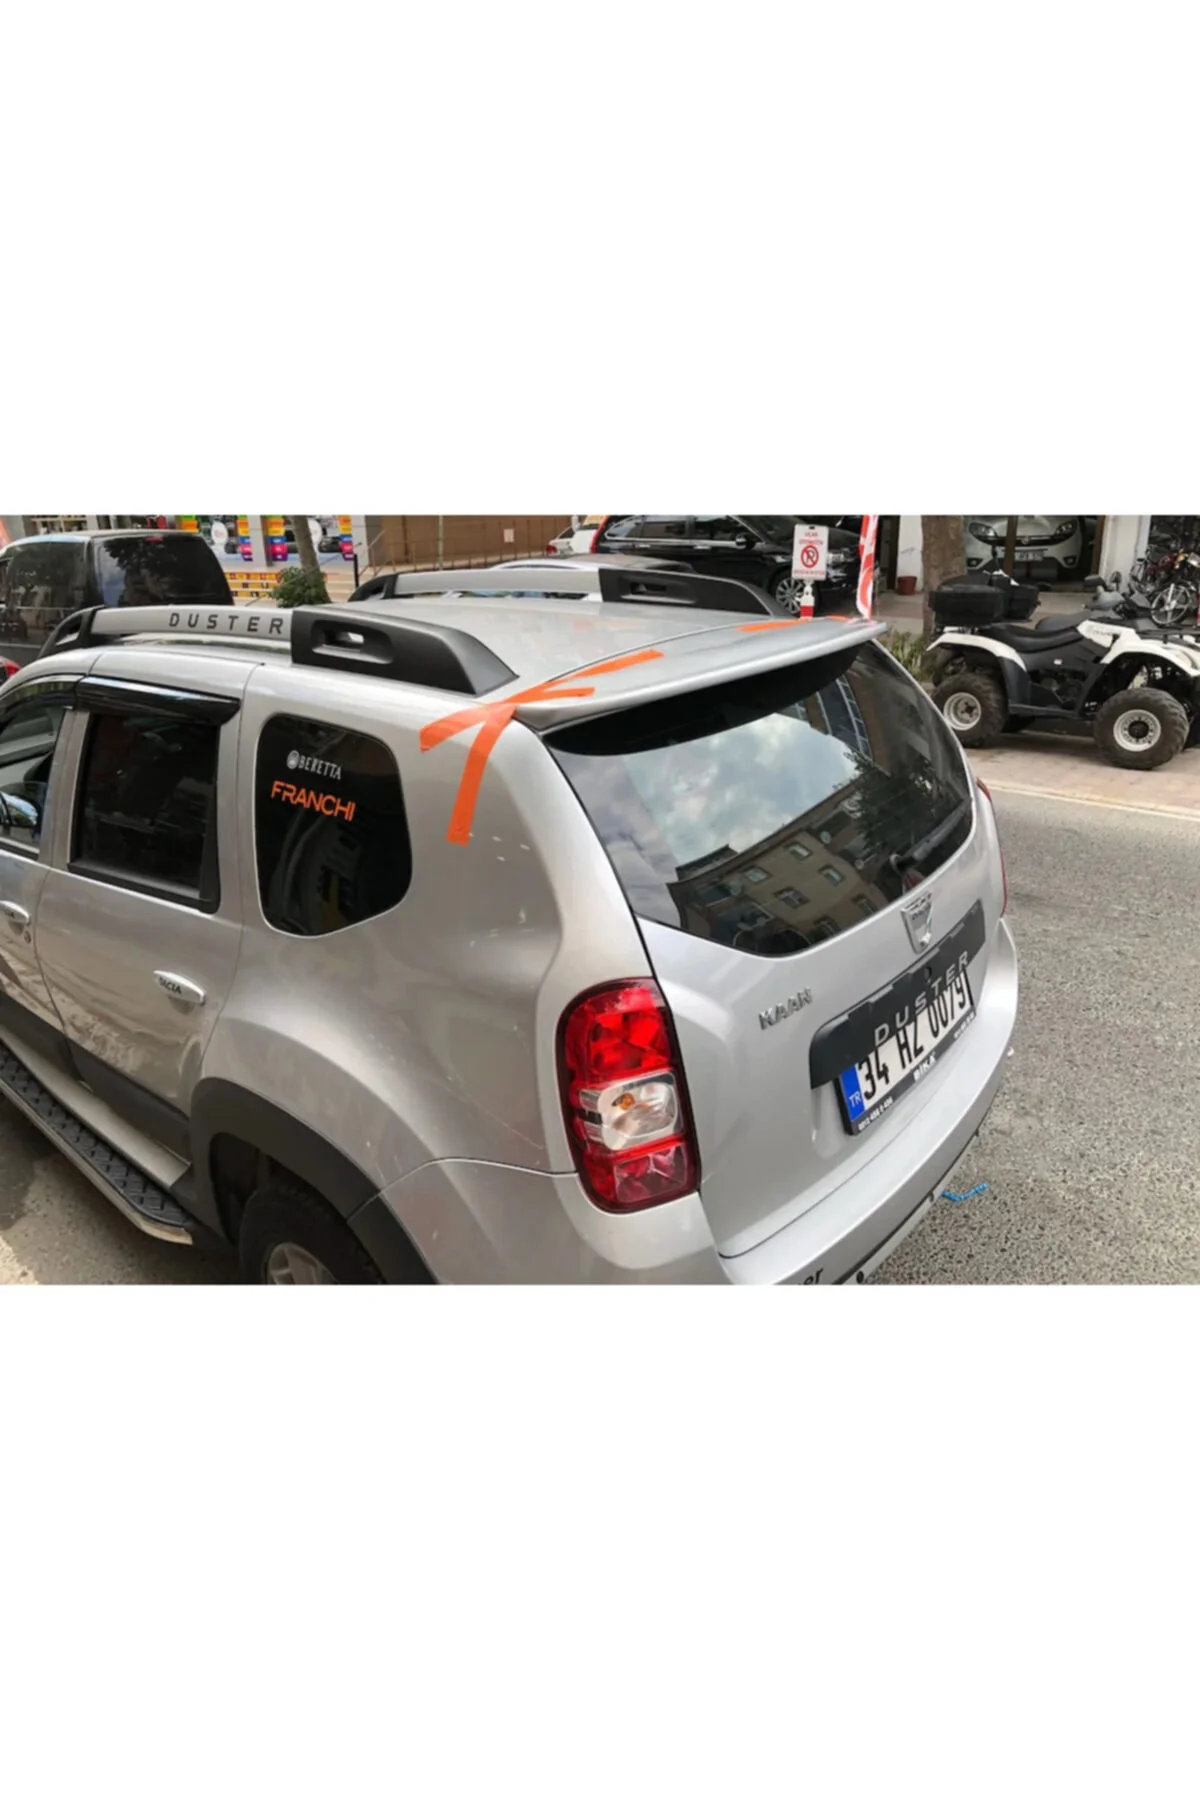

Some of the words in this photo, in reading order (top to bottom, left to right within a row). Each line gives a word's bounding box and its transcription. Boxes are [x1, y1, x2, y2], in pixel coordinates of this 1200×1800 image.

[168, 612, 284, 634] DUSTER
[298, 754, 342, 780] BERETTA
[271, 780, 356, 822] FRANCHI
[874, 950, 968, 1047] DUSTER
[859, 1047, 890, 1100] 34
[896, 1018, 924, 1070] HZ
[848, 1090, 862, 1108] TR
